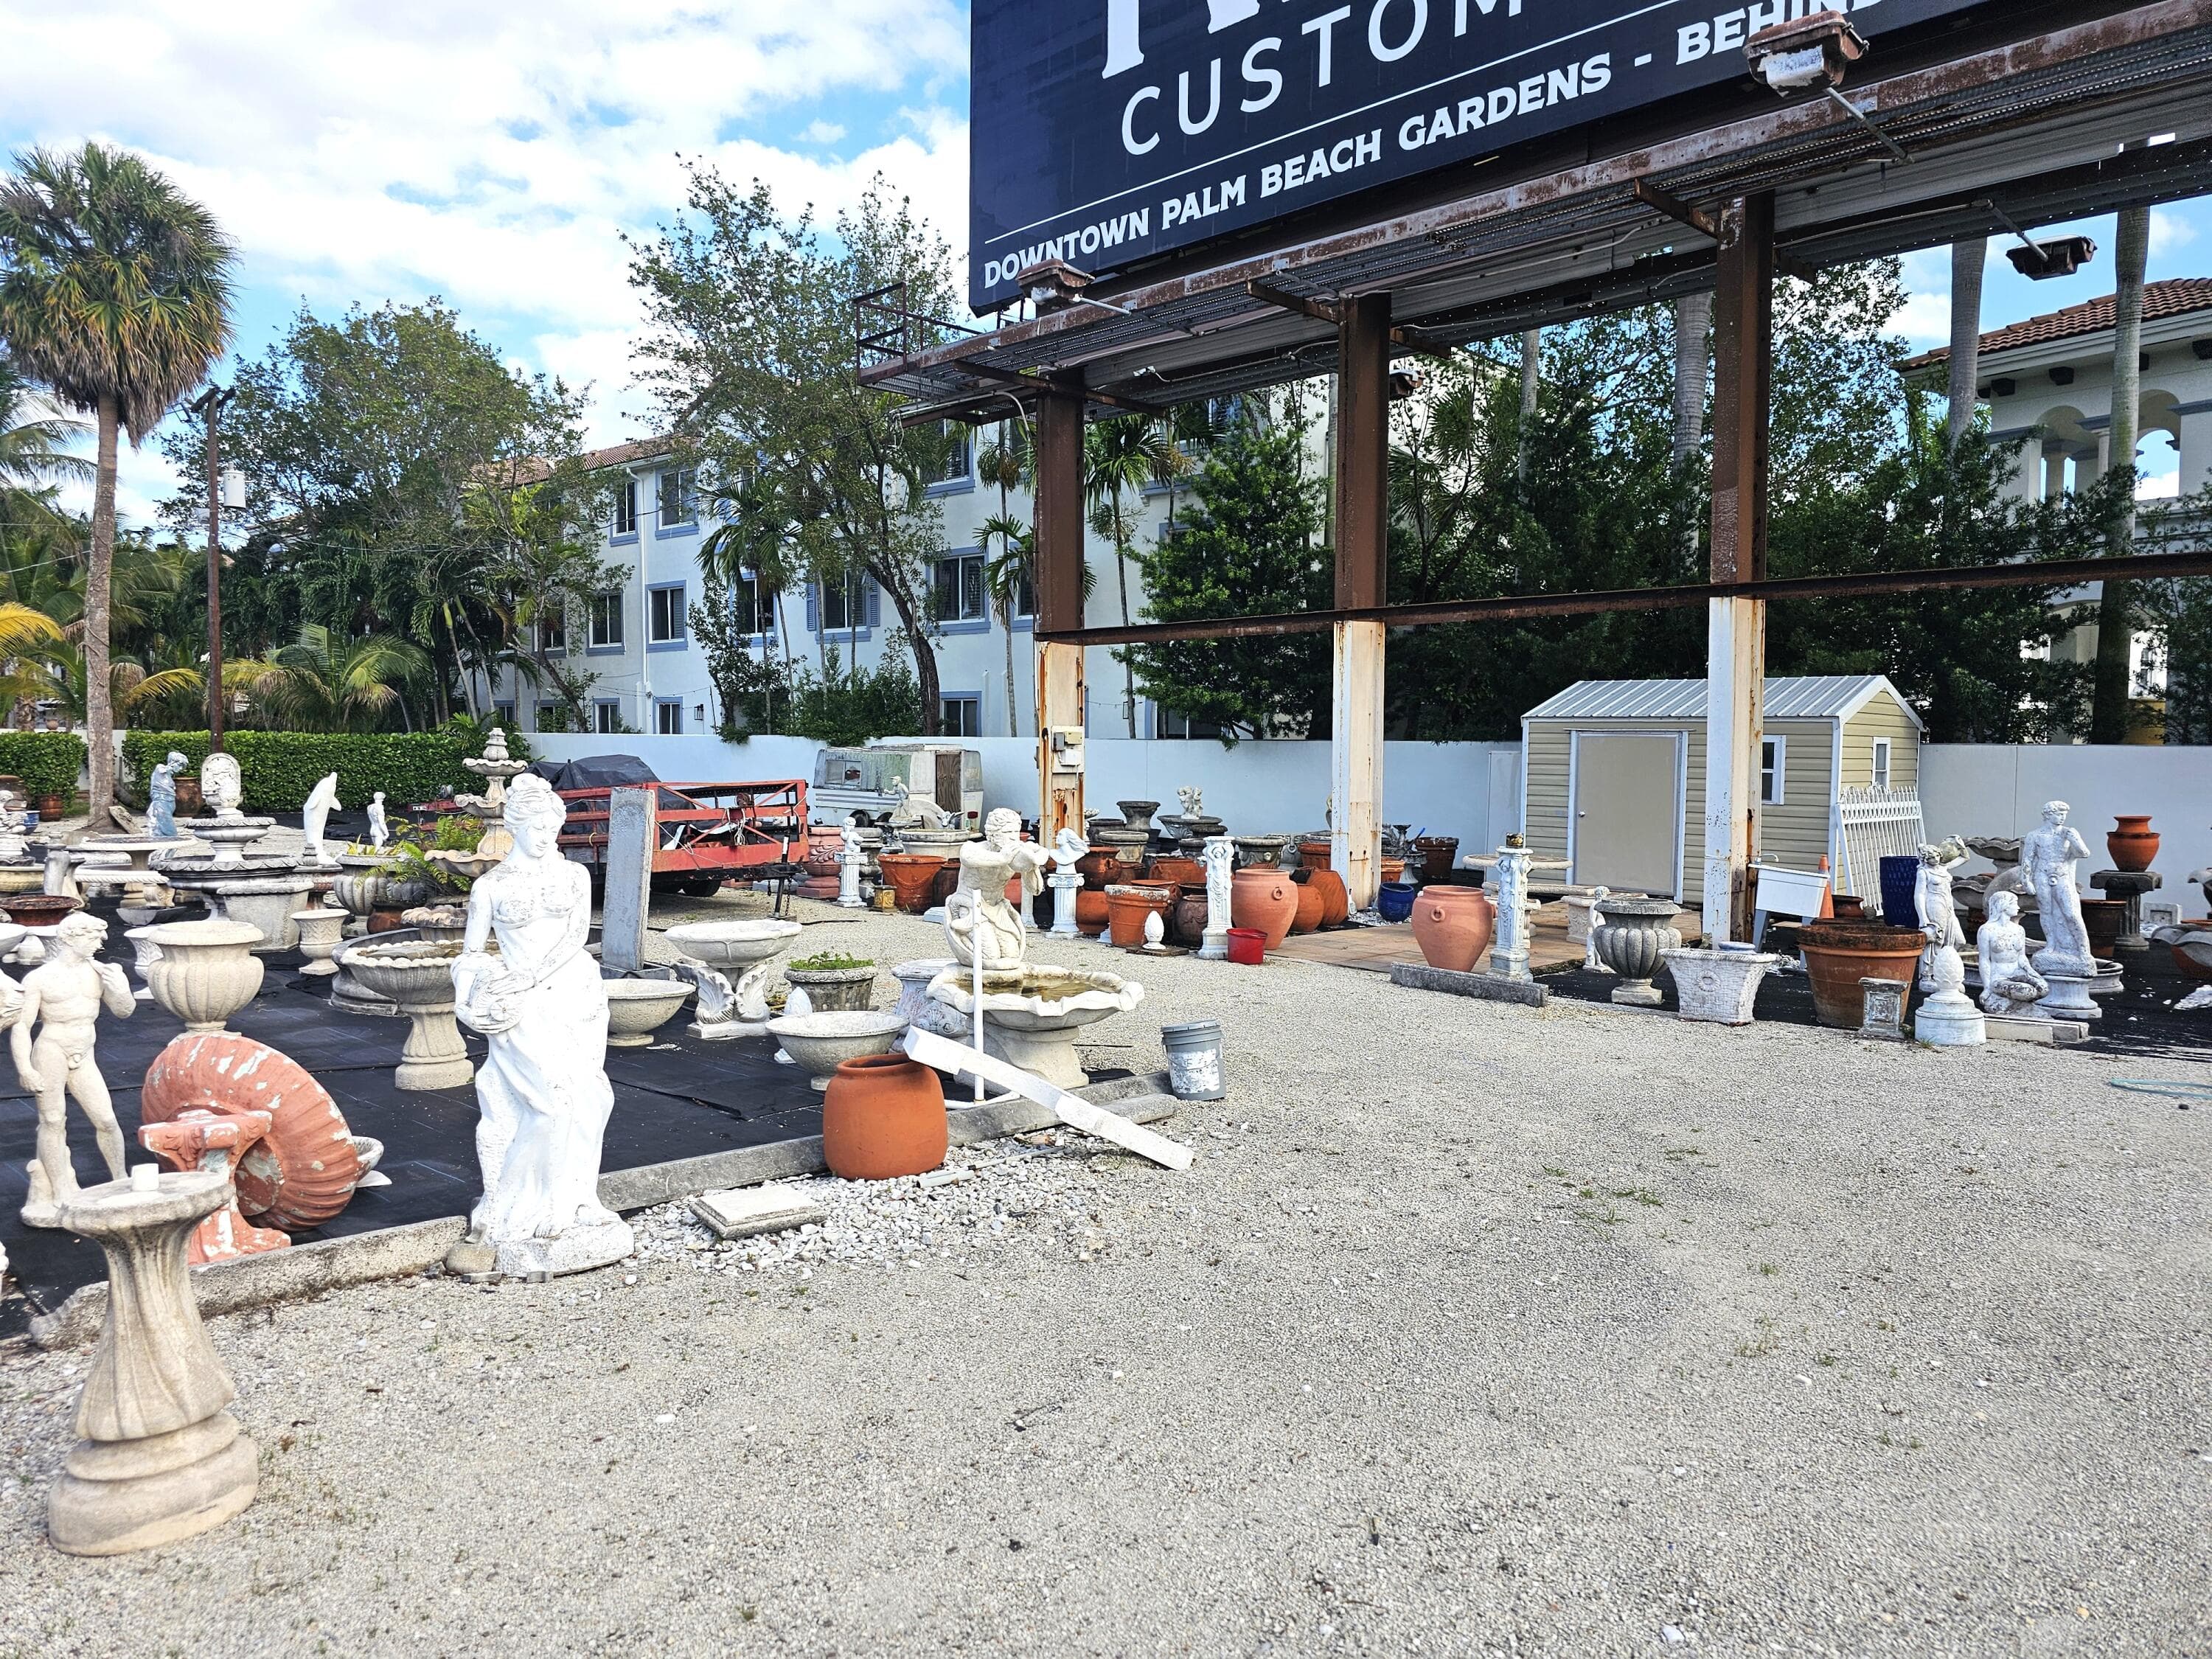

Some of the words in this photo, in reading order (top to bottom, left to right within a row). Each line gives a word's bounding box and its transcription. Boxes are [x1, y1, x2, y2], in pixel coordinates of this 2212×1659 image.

[985, 208, 1150, 288] DOWNTOWN
[1162, 175, 1246, 229] PALM
[1261, 129, 1382, 198] BEACH
[1399, 52, 1612, 150] GARDENS
[1676, 0, 1881, 65] BEHI
